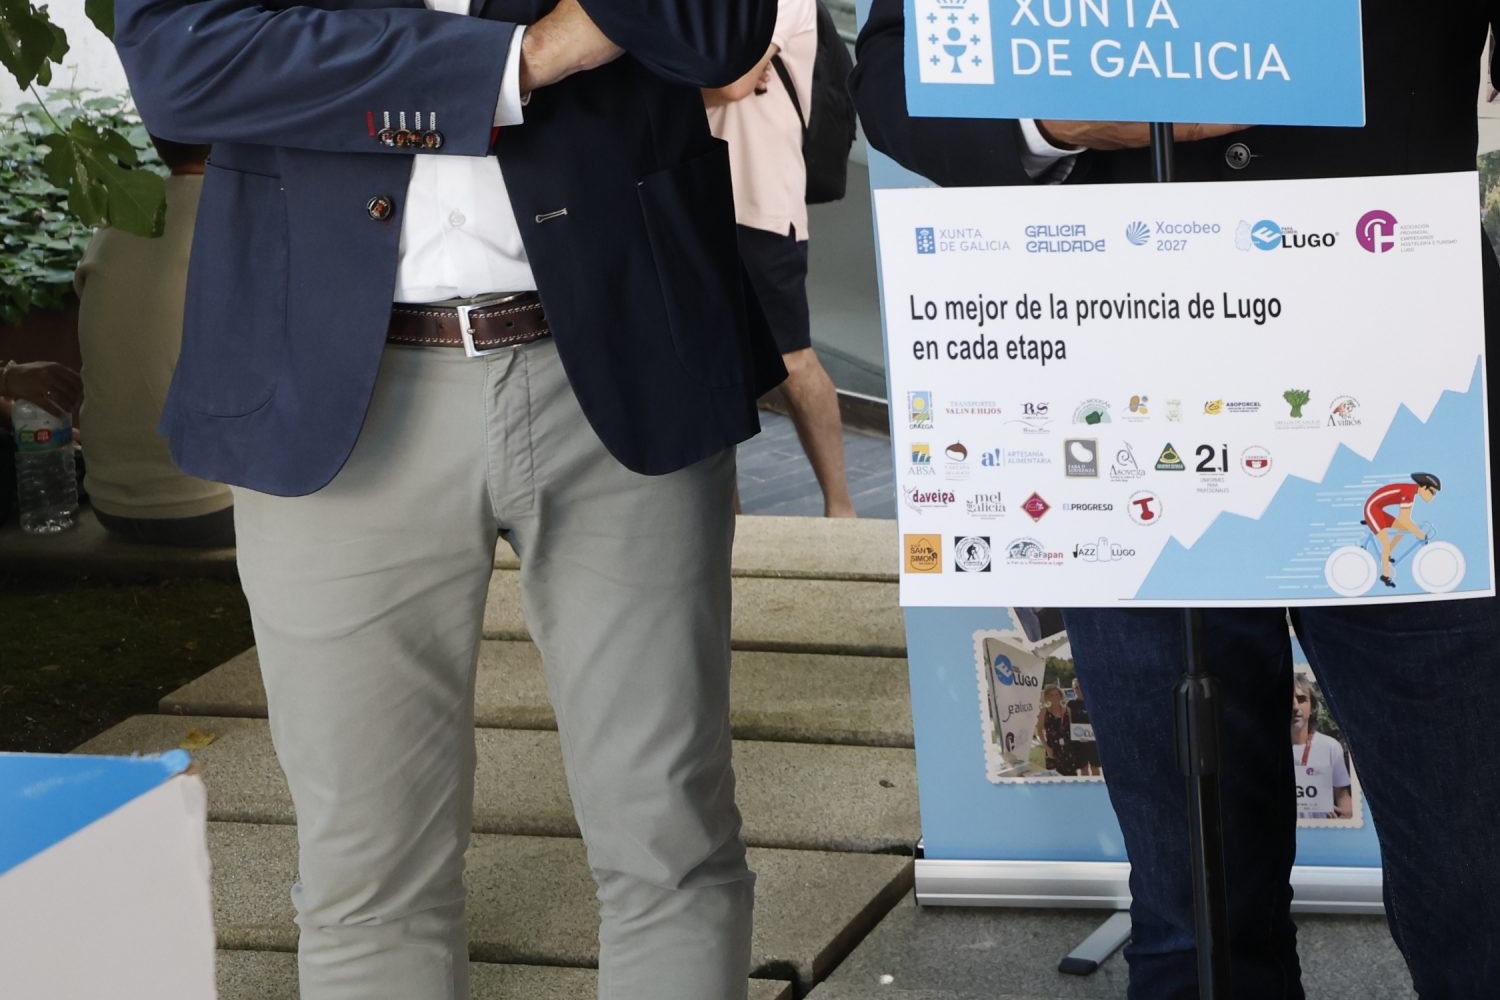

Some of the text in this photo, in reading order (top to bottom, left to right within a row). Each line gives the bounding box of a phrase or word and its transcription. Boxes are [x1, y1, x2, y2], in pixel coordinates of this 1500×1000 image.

[1011, 38, 1291, 81] DE GALICIA
[939, 228, 983, 239] XUNTA
[1025, 224, 1086, 238] GALICIA
[1155, 220, 1221, 235] Xacobeo
[940, 240, 1010, 252] DE GALICIA
[1026, 239, 1106, 253] CALIDADE
[1157, 240, 1187, 252] 2027
[1281, 232, 1336, 249] LUGO
[910, 292, 1282, 327] Lo mejor de la provincia de Lugo
[913, 334, 1067, 366] en cada etapa
[908, 466, 936, 476] ABSA
[912, 489, 956, 504] daveiga
[1112, 549, 1136, 557] LUGO
[1013, 672, 1039, 687] LUGO
